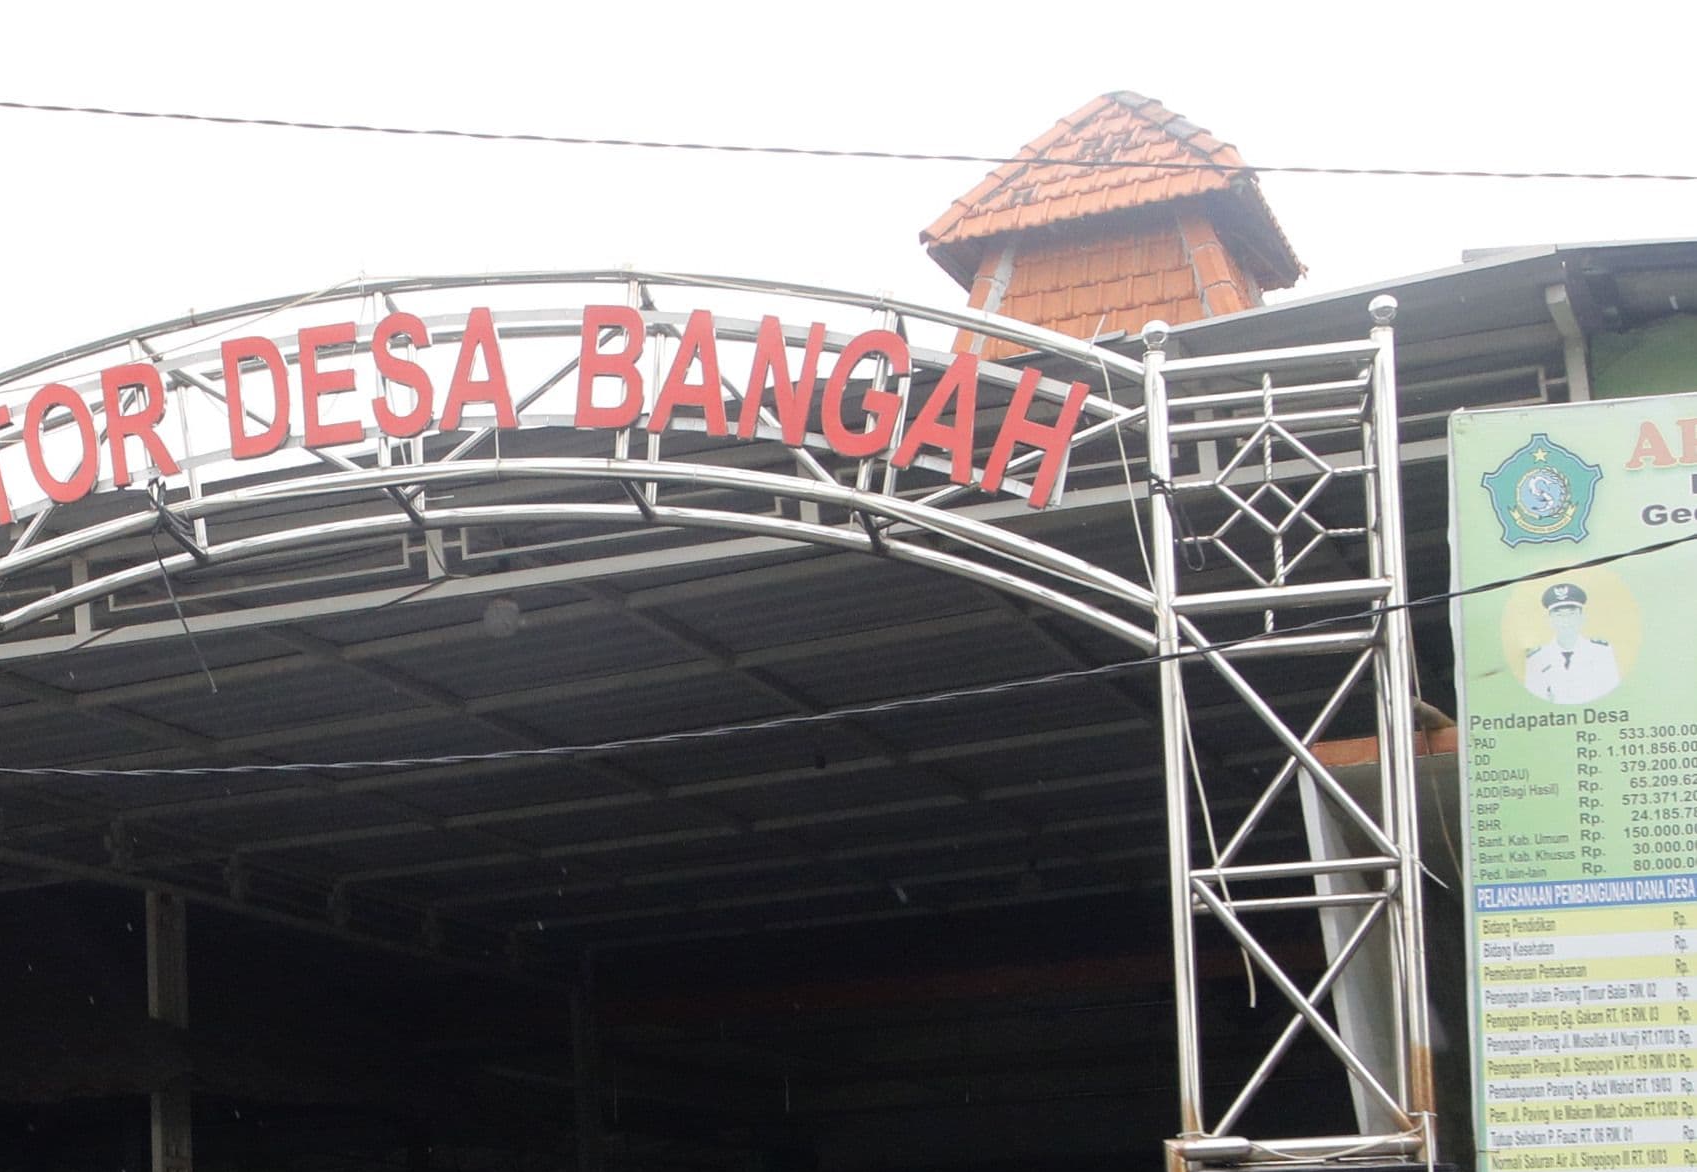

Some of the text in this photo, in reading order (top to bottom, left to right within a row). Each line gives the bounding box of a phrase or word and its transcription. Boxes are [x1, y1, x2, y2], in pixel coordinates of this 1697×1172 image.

[221, 307, 519, 459] DESA
[575, 304, 1089, 508] BANGAH
[1641, 504, 1697, 526] Ge
[1470, 708, 1629, 731] Pendapatan Desa
[1474, 737, 1496, 749] PAD
[1576, 731, 1600, 744] Rp.
[1577, 747, 1601, 760] Rp.
[1578, 763, 1602, 777] Rp.
[1578, 780, 1603, 793] Rp.
[1579, 796, 1604, 810] Rp.
[1580, 813, 1605, 826] Rp.
[1580, 829, 1605, 843] Rp.
[1581, 845, 1606, 859] Rp.
[1582, 862, 1607, 876] Rp.
[1477, 877, 1695, 908] PELAKSANAAN PEMBANGUNAN DANA DESA
